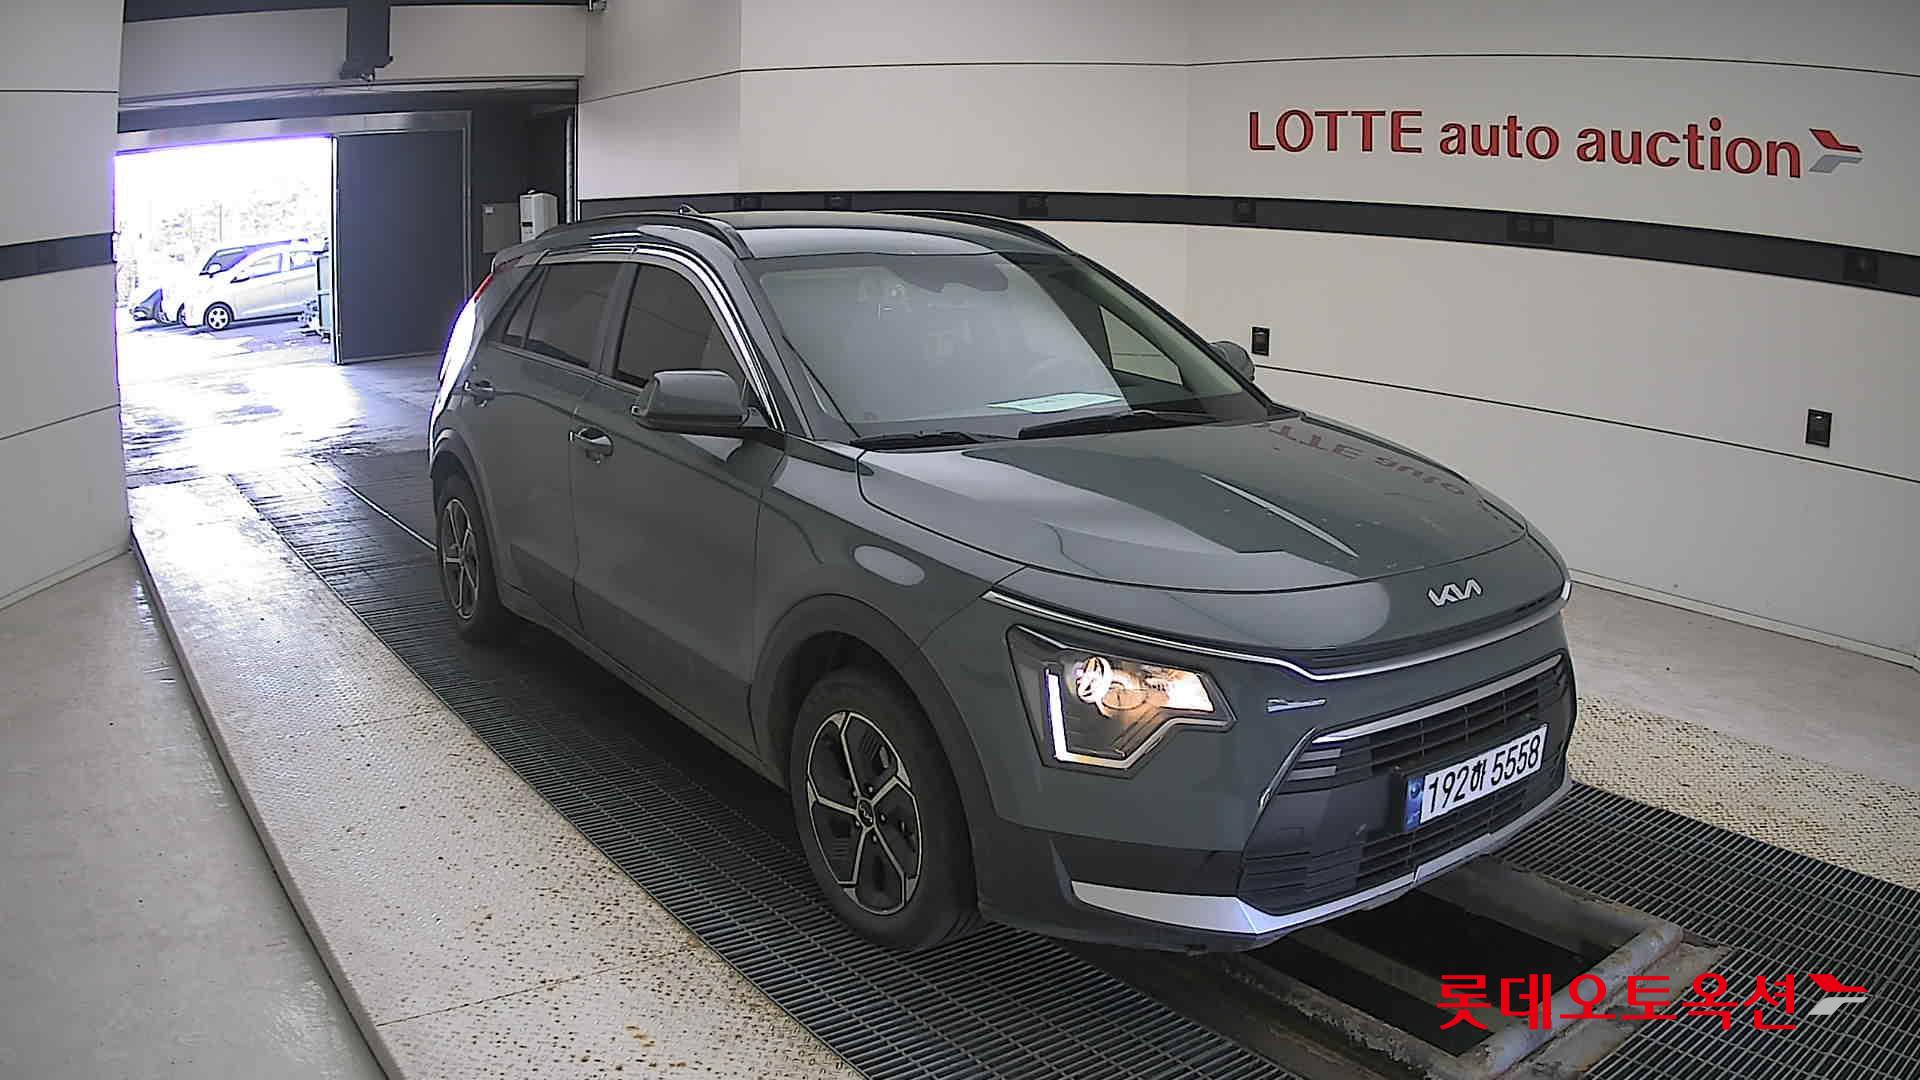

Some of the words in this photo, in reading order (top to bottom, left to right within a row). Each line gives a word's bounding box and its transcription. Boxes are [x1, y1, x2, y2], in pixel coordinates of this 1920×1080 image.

[1249, 110, 1423, 154] LOTTE
[1439, 115, 1560, 161] auto
[1577, 117, 1801, 178] auction
[1491, 735, 1541, 786] 5558
